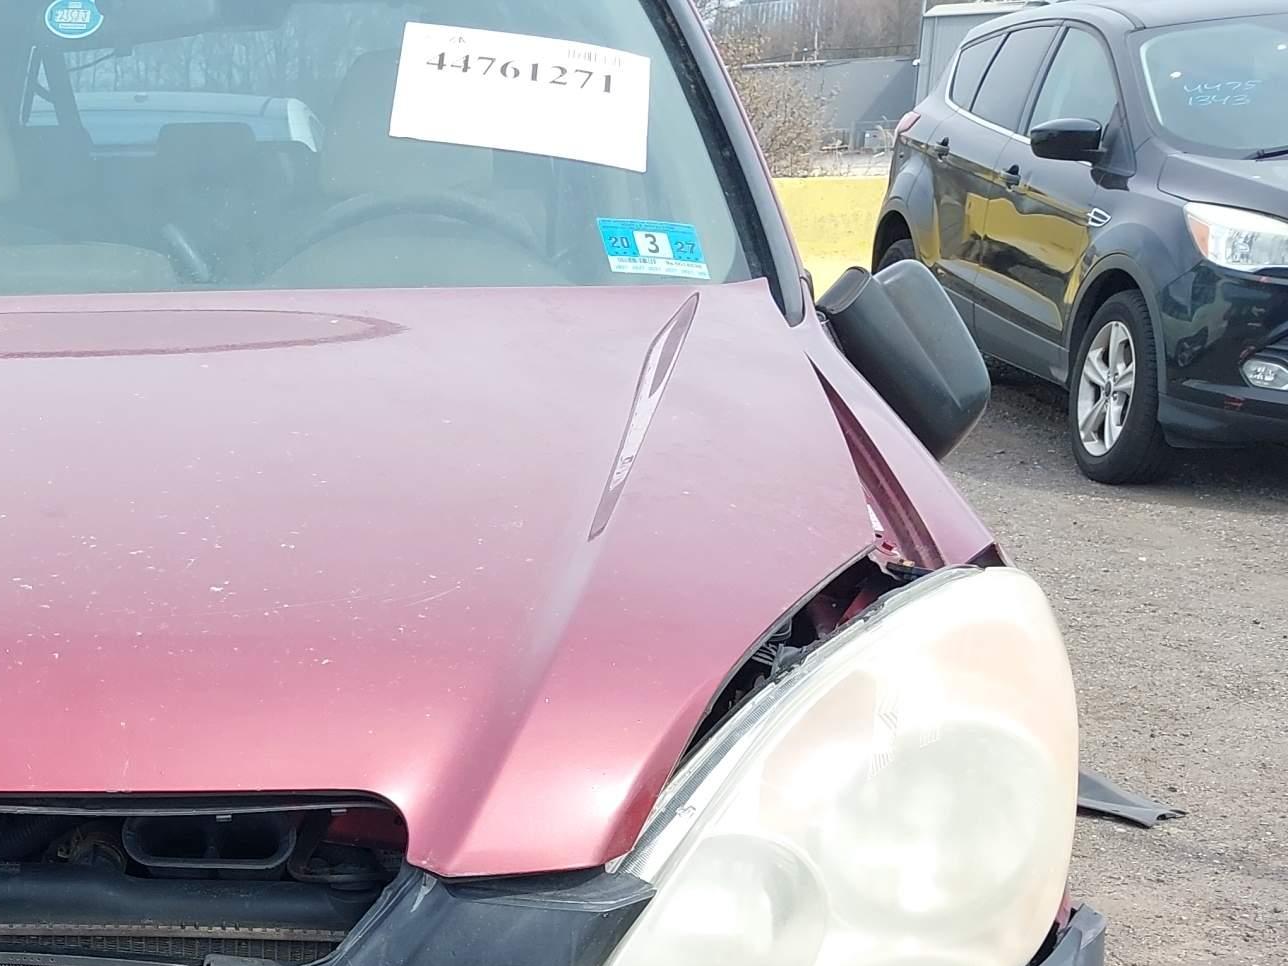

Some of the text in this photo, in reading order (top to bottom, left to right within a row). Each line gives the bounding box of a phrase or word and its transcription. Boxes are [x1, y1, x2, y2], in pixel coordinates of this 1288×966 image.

[426, 52, 612, 93] 44761271
[608, 233, 697, 254] 20 3 27
